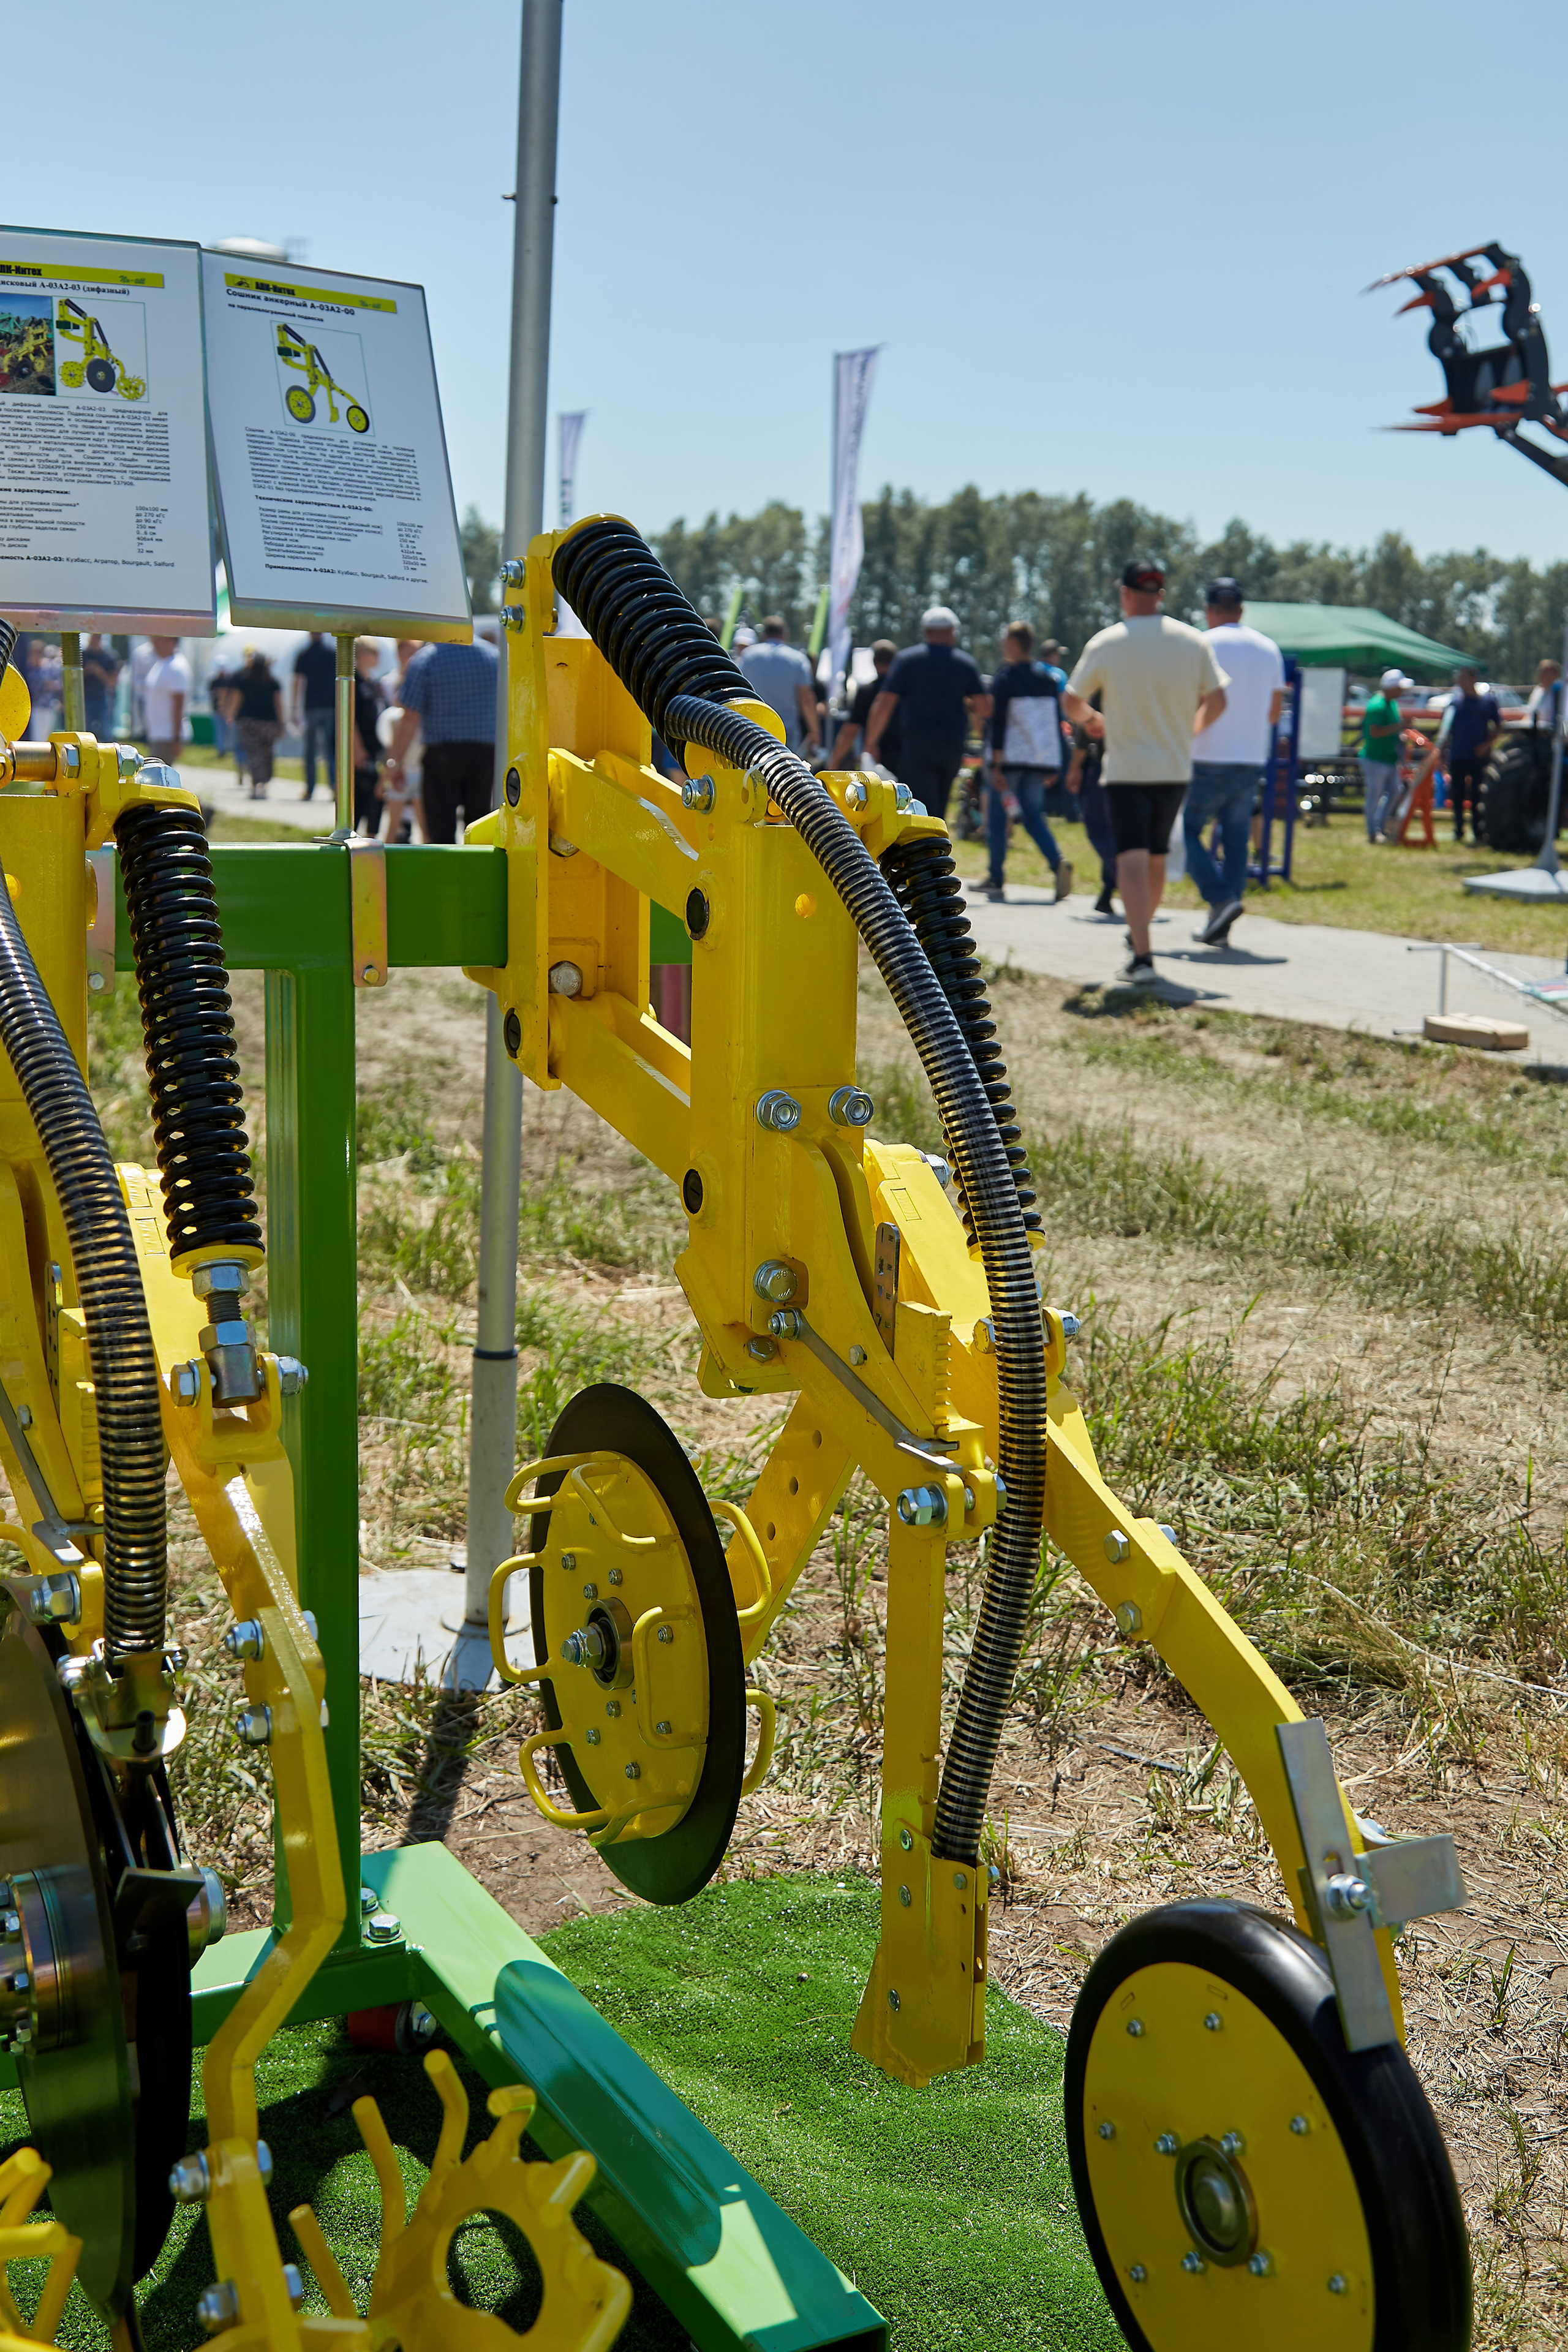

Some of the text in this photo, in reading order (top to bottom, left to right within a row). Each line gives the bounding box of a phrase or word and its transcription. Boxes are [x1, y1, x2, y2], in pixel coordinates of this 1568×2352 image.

[0, 264, 42, 276] ПК-Интех
[82, 285, 129, 295] (дифазный)
[226, 288, 262, 300] Сошник
[263, 296, 307, 307] анкерный
